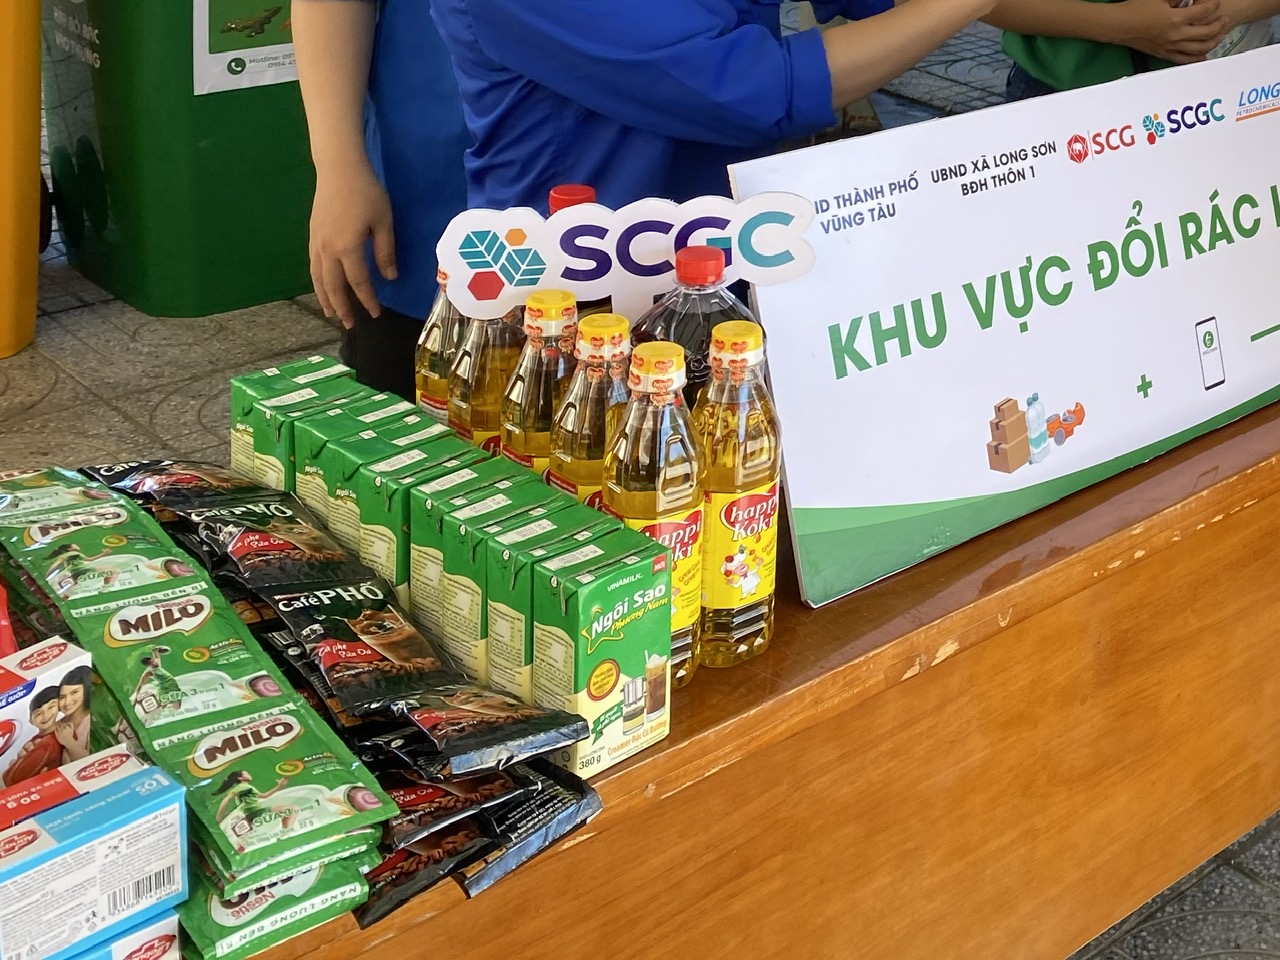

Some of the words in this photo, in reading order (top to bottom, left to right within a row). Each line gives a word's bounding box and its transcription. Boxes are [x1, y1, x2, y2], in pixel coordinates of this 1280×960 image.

[1236, 101, 1280, 117] PETROCHEMICALS
[1238, 82, 1280, 107] LONG
[1166, 98, 1226, 134] SCGC
[1093, 124, 1136, 155] SCG
[930, 162, 968, 184] UBND
[970, 155, 991, 174] XÃ
[993, 148, 1029, 169] LONG
[1031, 140, 1058, 159] SƠN
[833, 184, 885, 210] THÀNH
[889, 169, 920, 196] PHỐ
[960, 177, 989, 197] BĐH
[990, 168, 1027, 189] THÔN
[1028, 165, 1037, 178] 1
[819, 208, 866, 235] VŨNG
[867, 202, 897, 223] TÀU
[559, 211, 796, 282] SCGC
[827, 296, 948, 381] KHU
[961, 254, 1074, 334] VỰC
[1086, 200, 1171, 292] ĐỔI
[1178, 188, 1262, 263] RÁC
[730, 496, 778, 523] happ
[733, 511, 774, 542] Koki
[118, 602, 205, 636] MILO
[591, 596, 629, 640] Ngôi
[633, 584, 666, 608] Sao
[644, 597, 669, 616] Nam
[202, 702, 211, 710] 22
[203, 721, 294, 765] MILO
[607, 739, 631, 757] Creamer
[79, 754, 127, 778] Lifebuoy
[579, 755, 595, 771] 380
[596, 754, 602, 764] g
[20, 793, 41, 805] 90
[314, 799, 321, 808] 1
[299, 820, 308, 829] 22
